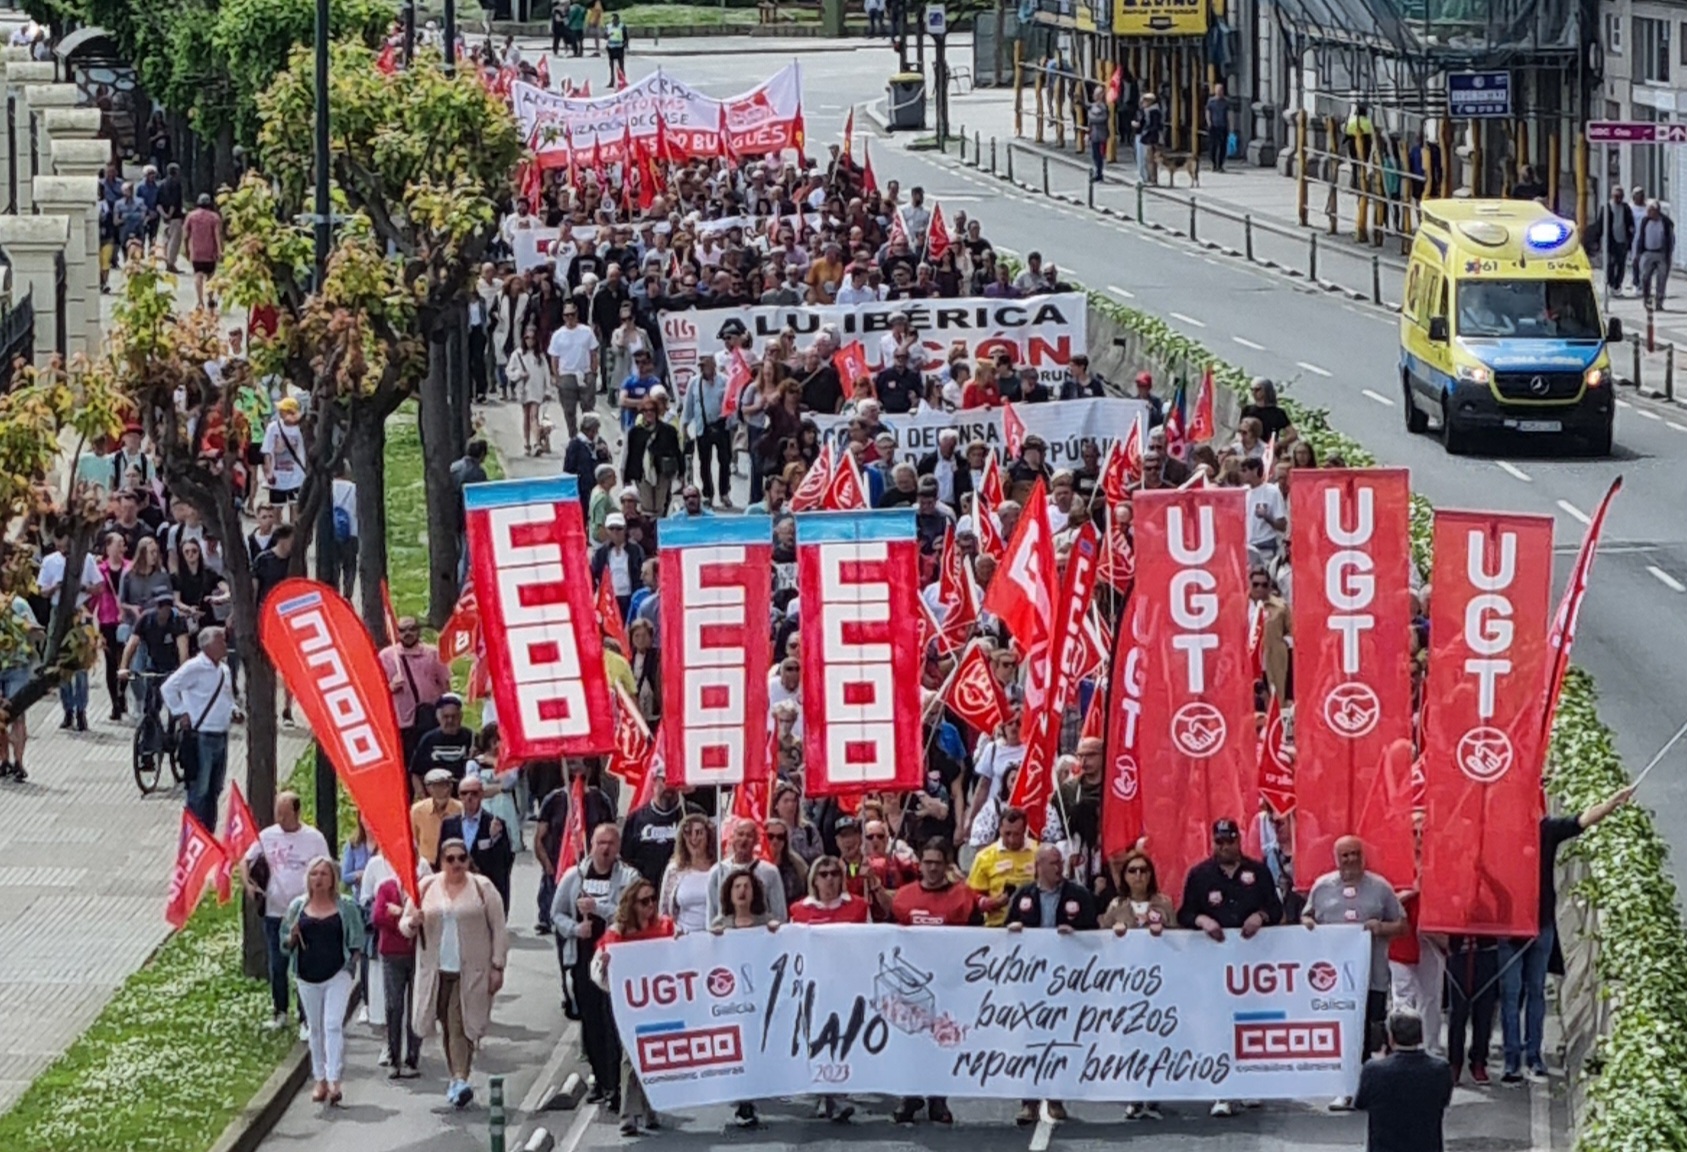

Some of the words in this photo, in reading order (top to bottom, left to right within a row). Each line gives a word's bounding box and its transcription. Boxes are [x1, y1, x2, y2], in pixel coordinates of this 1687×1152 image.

[692, 123, 787, 150] BUGUÉS
[843, 304, 1069, 333] IBÉRICA
[1166, 505, 1220, 693] UGT
[1323, 487, 1376, 674] UGT
[488, 502, 591, 741] CCOO
[1464, 530, 1517, 719] UGT
[681, 545, 746, 785] CCOO
[819, 542, 896, 784] CCOO
[624, 971, 700, 1009] UGT
[964, 943, 1046, 985] Subir
[1046, 956, 1163, 997] salarios
[1226, 962, 1300, 996] UGT
[711, 1001, 757, 1018] Galicia
[974, 990, 1068, 1030] baxar
[1074, 1000, 1179, 1042] prezos
[1310, 998, 1356, 1012] Galicia
[643, 1033, 737, 1066] CCOO
[952, 1040, 1080, 1087] repartir
[1079, 1039, 1230, 1087] beneficios
[1241, 1026, 1335, 1053] CCOO
